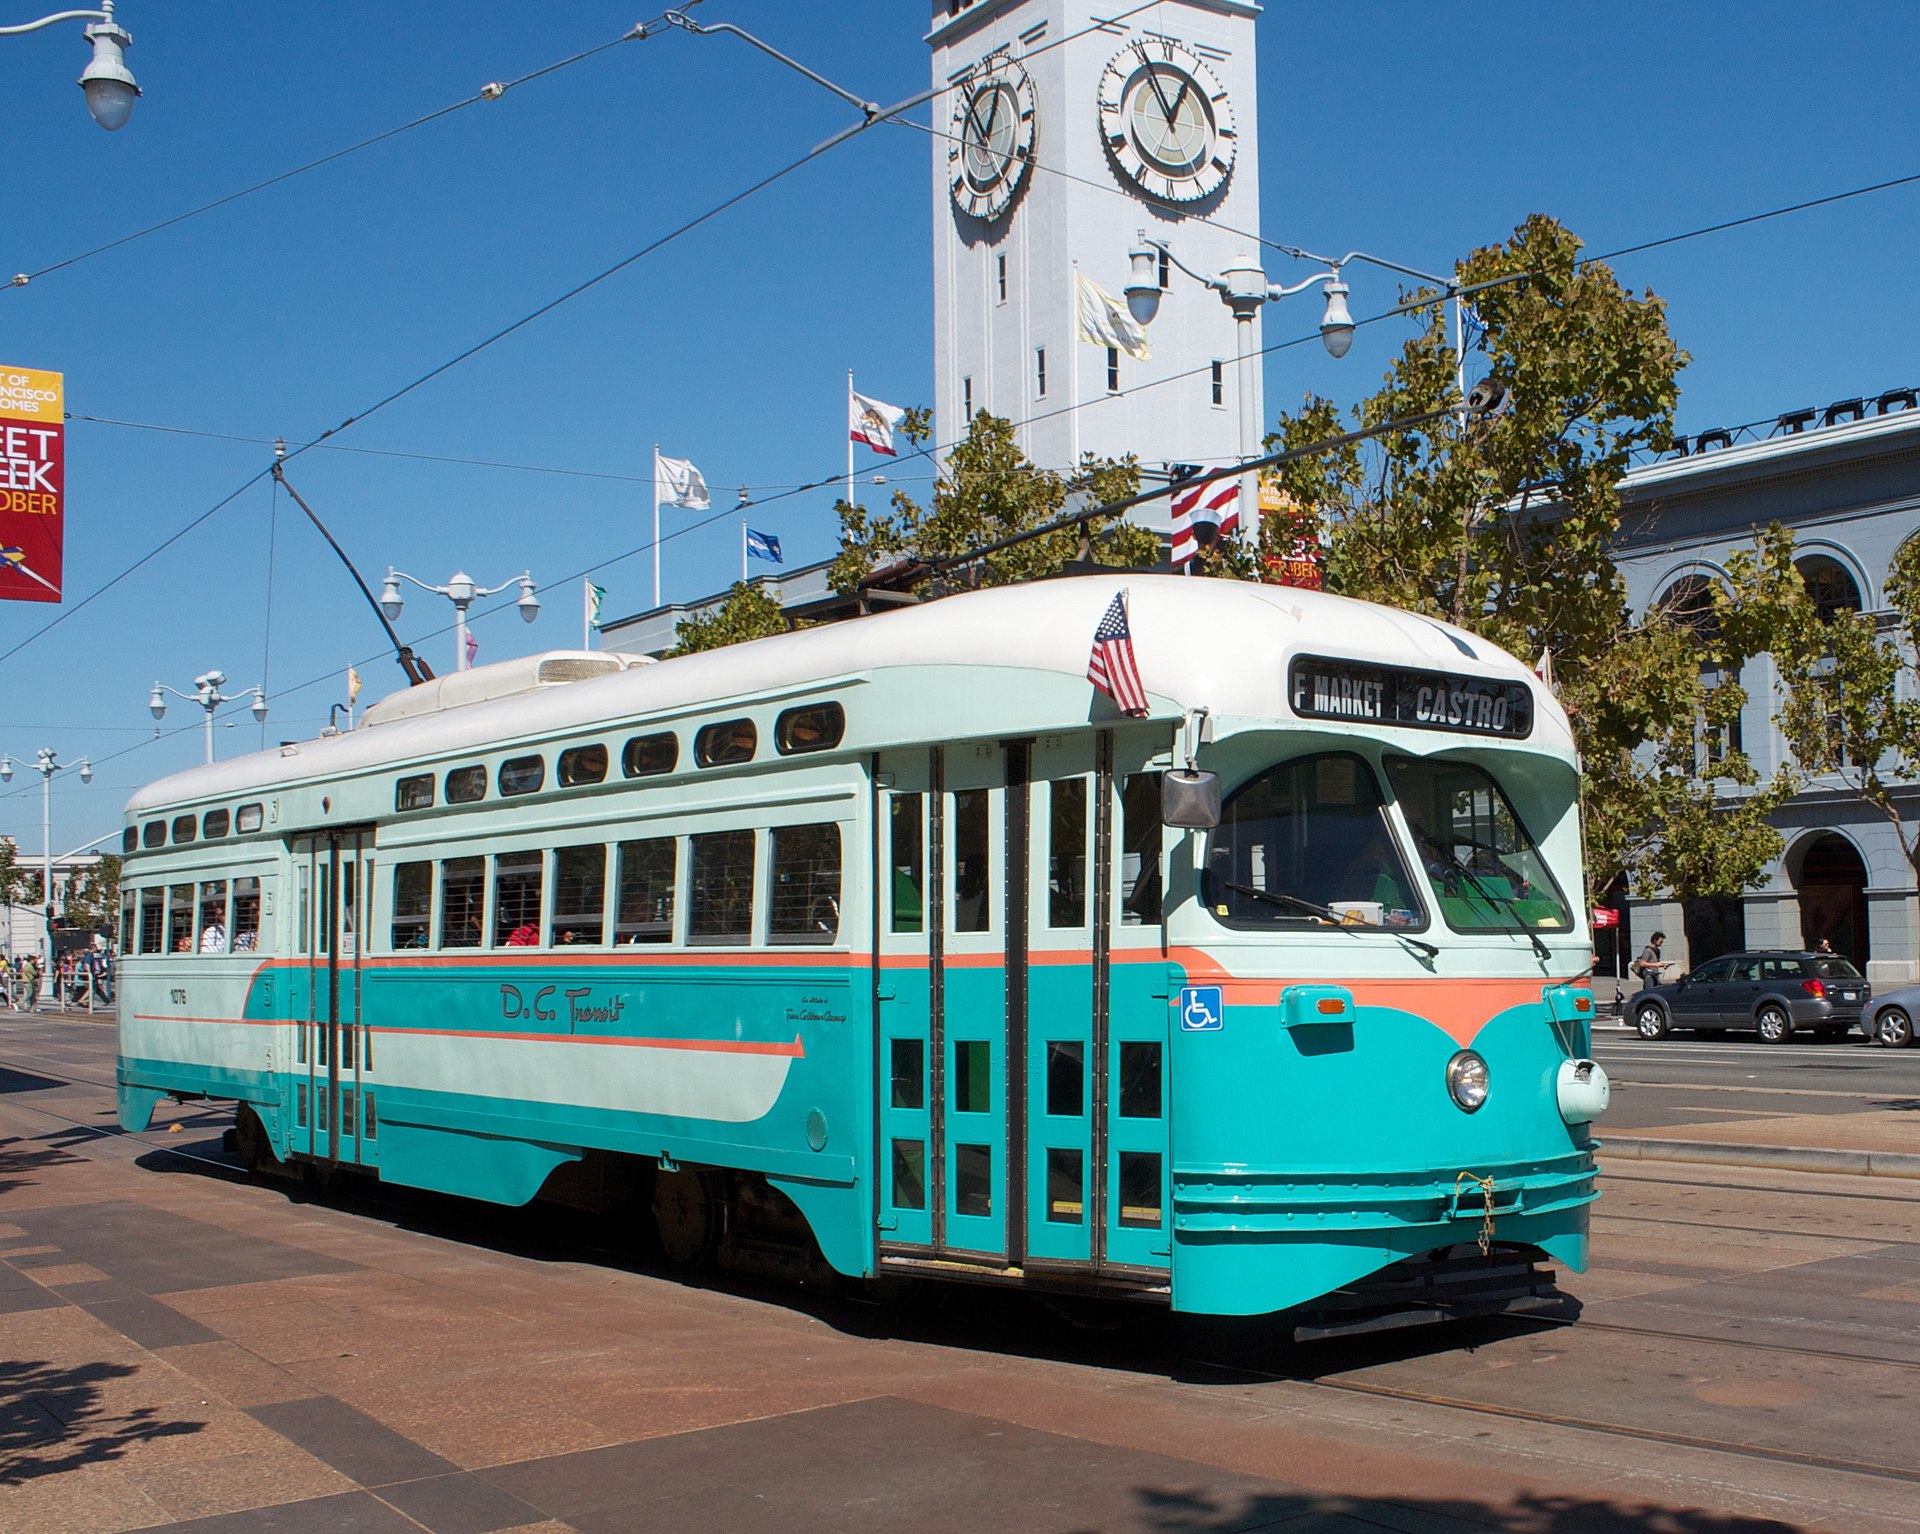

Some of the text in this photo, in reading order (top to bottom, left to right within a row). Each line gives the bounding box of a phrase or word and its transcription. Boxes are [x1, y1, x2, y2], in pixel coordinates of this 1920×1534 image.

[8, 374, 30, 386] OF
[0, 425, 58, 461] ET
[1294, 672, 1508, 731] F MARKET CASTRO
[170, 988, 187, 1005] 1076
[564, 987, 625, 1036] Transit
